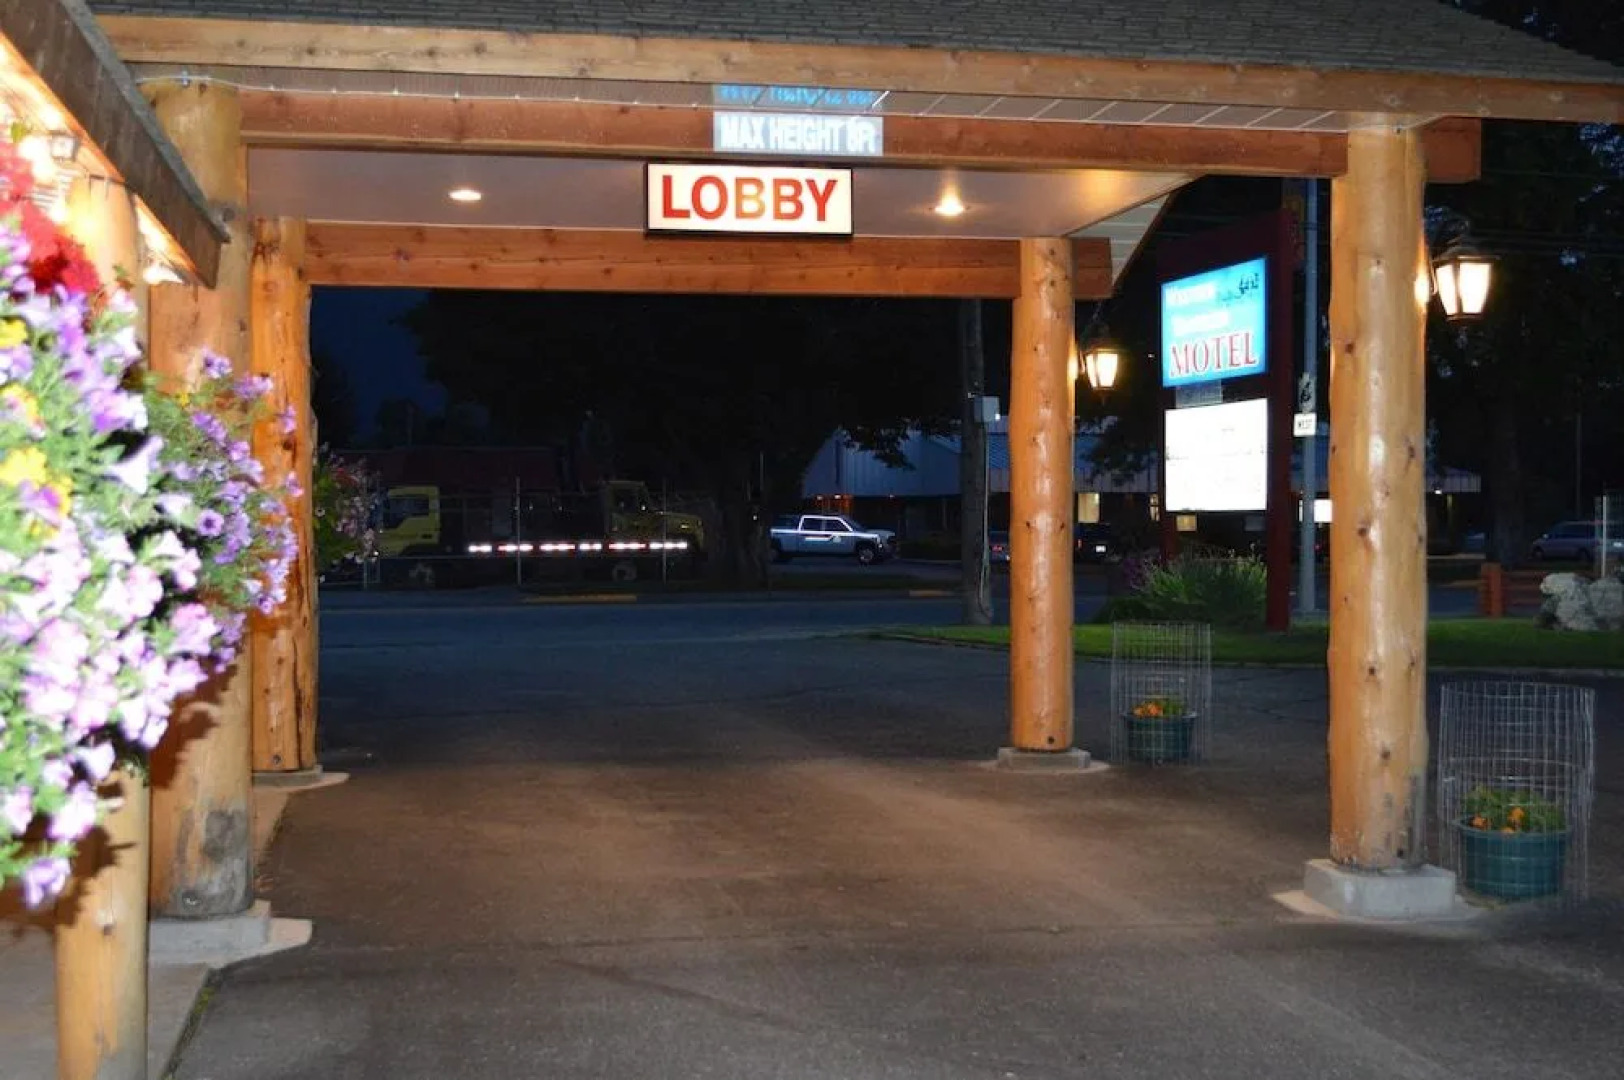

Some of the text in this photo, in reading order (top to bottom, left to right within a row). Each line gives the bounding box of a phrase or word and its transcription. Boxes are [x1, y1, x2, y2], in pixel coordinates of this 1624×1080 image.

[719, 114, 765, 152] MAX
[769, 115, 842, 154] HEIGHT
[662, 174, 838, 222] LOBBY
[1170, 332, 1257, 377] MOTEL
